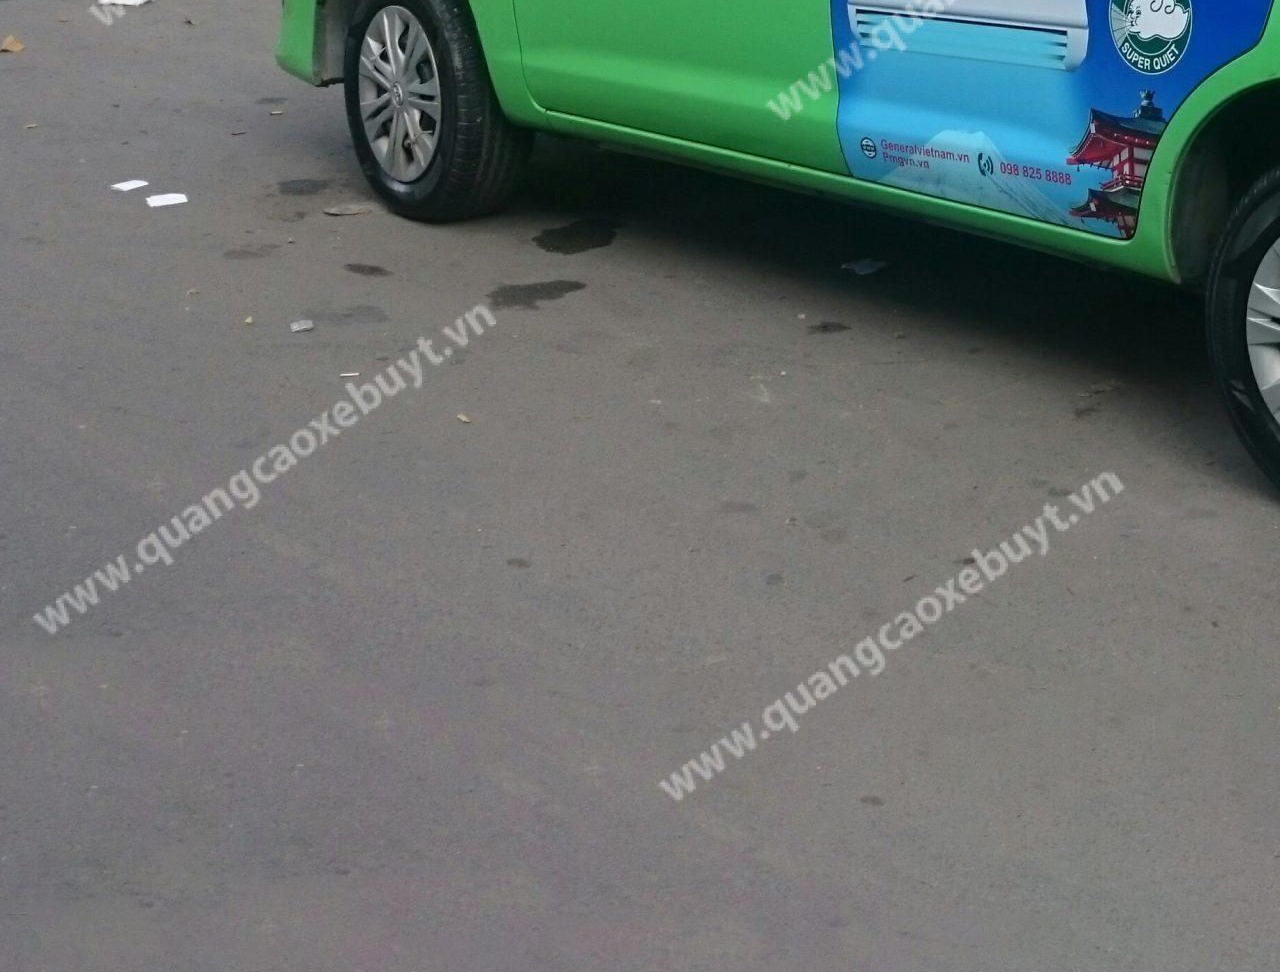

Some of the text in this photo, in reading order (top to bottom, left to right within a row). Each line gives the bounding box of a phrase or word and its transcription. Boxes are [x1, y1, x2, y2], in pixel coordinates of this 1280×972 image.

[1121, 42, 1179, 70] SUPER QUIET
[880, 139, 970, 164] Generalvietnam.vn
[1000, 162, 1019, 176] 098
[1023, 166, 1042, 180] 825
